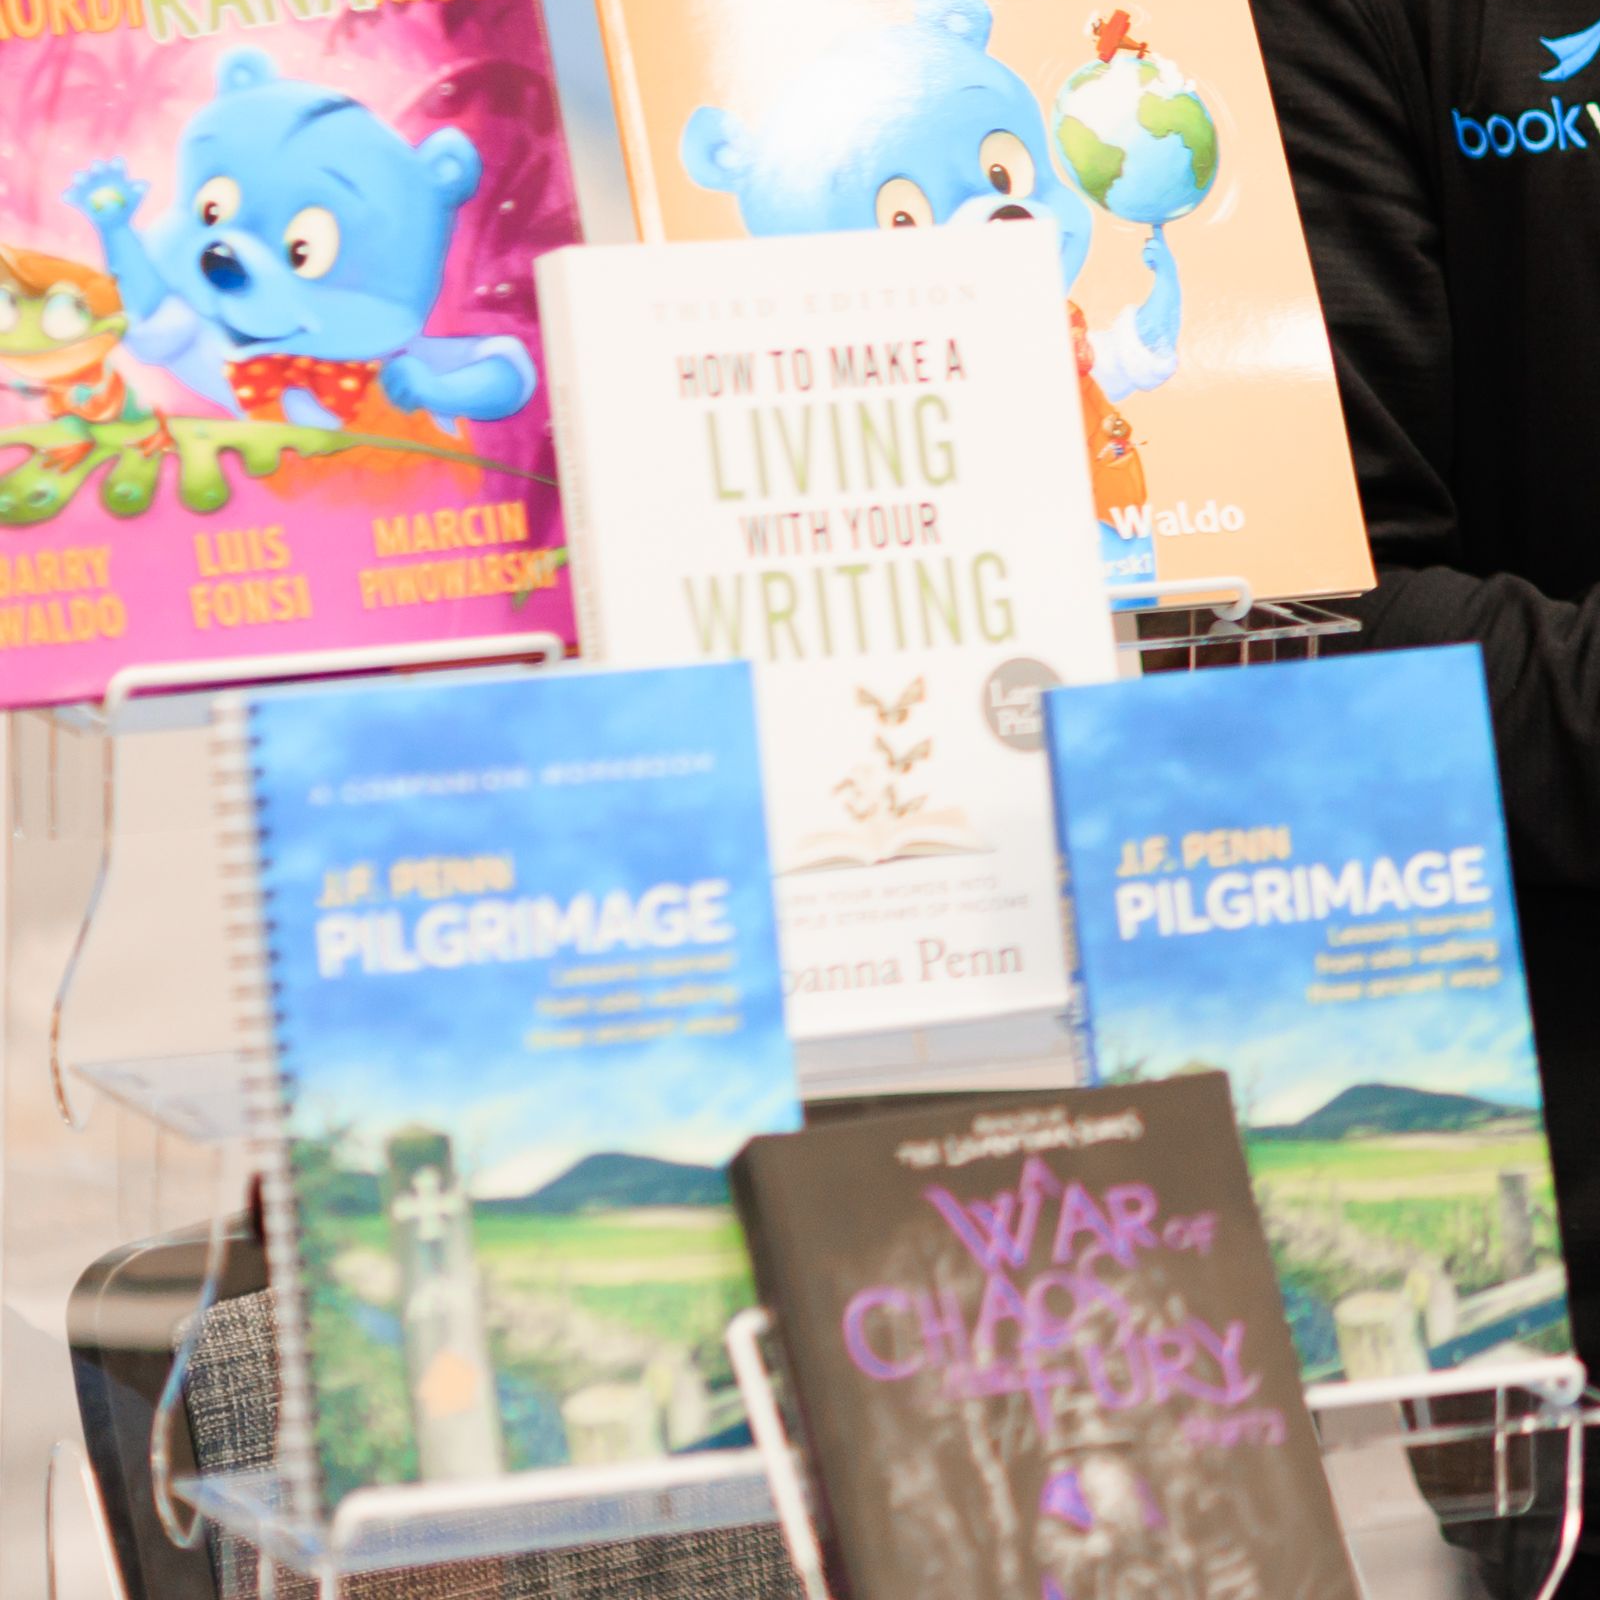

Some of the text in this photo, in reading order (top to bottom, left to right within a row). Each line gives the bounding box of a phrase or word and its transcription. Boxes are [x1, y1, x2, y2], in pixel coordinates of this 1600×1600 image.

[676, 337, 968, 398] HOW TO MAKE A
[704, 393, 959, 503] LIVING
[373, 502, 528, 558] MARCIN
[739, 501, 943, 558] WITH YOUR
[1108, 500, 1246, 540] Waldo
[195, 526, 291, 577] LUIS
[187, 575, 312, 631] FONSI
[681, 551, 1018, 663] WRITING
[1181, 826, 1293, 870] PENN
[1113, 844, 1494, 942] PILGRIMAGE
[314, 877, 735, 979] PILGRIMAGE
[917, 935, 1025, 982] Penn
[926, 1154, 1160, 1272] WAR
[843, 1243, 1131, 1381] CHAOS
[1019, 1317, 1264, 1437] FURY
